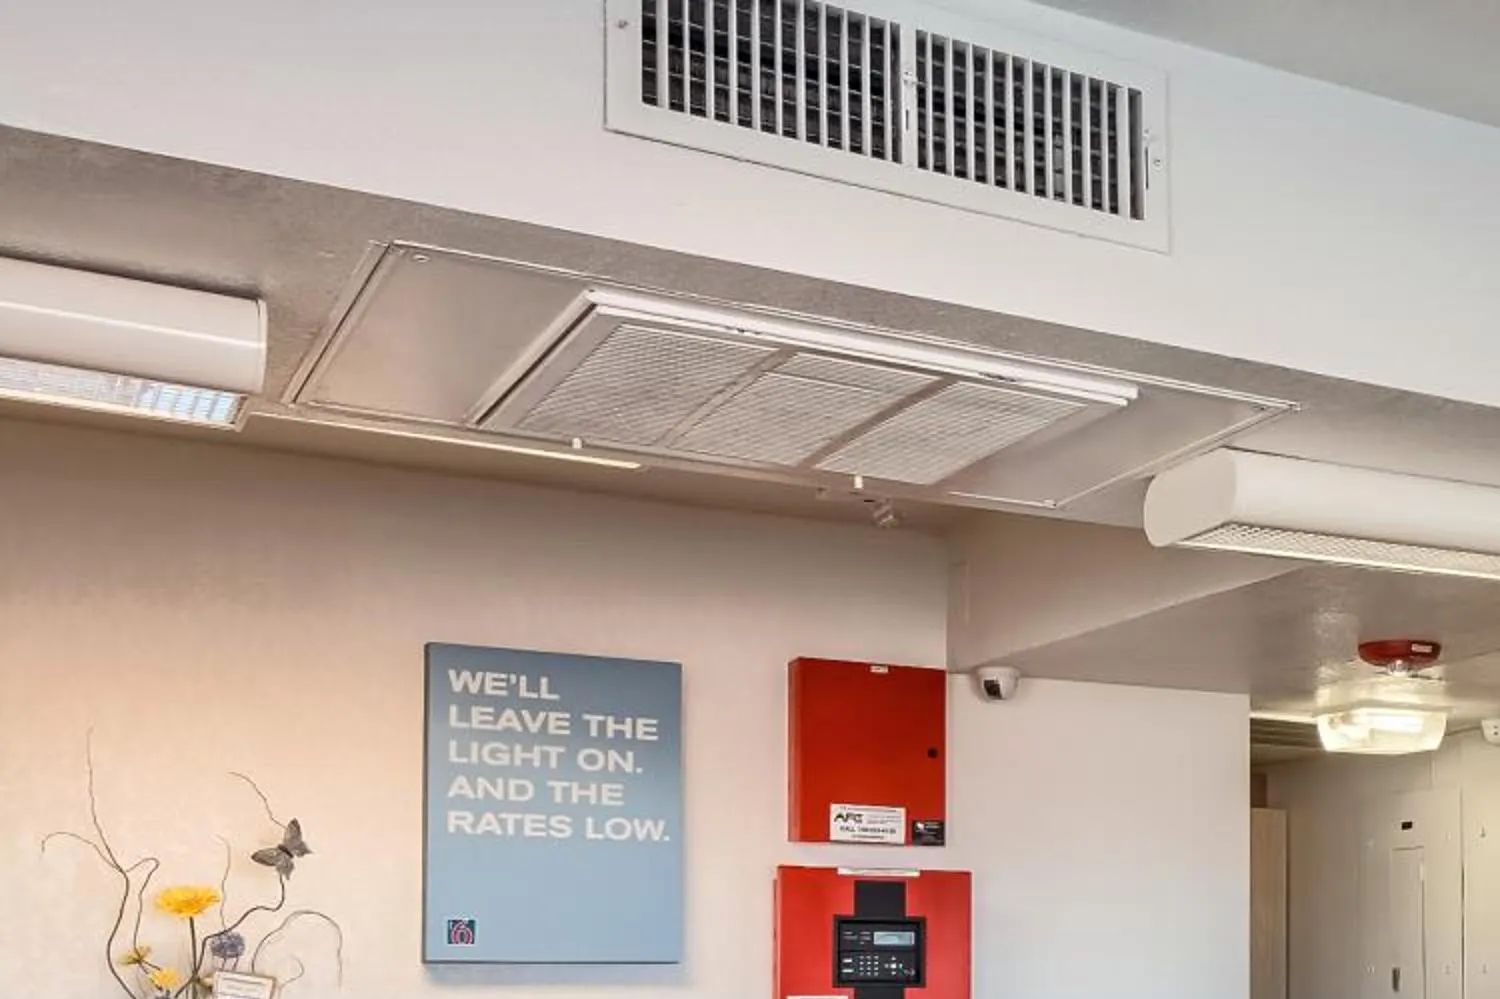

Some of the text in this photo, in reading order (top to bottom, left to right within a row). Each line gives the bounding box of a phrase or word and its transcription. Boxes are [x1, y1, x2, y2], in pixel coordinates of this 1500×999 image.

[448, 669, 560, 700] WE'LL
[449, 704, 659, 741] LEAVE THE
[449, 740, 643, 774] LIGHT ON.
[448, 775, 625, 806] AND THE
[448, 810, 671, 842] RATES LOW.
